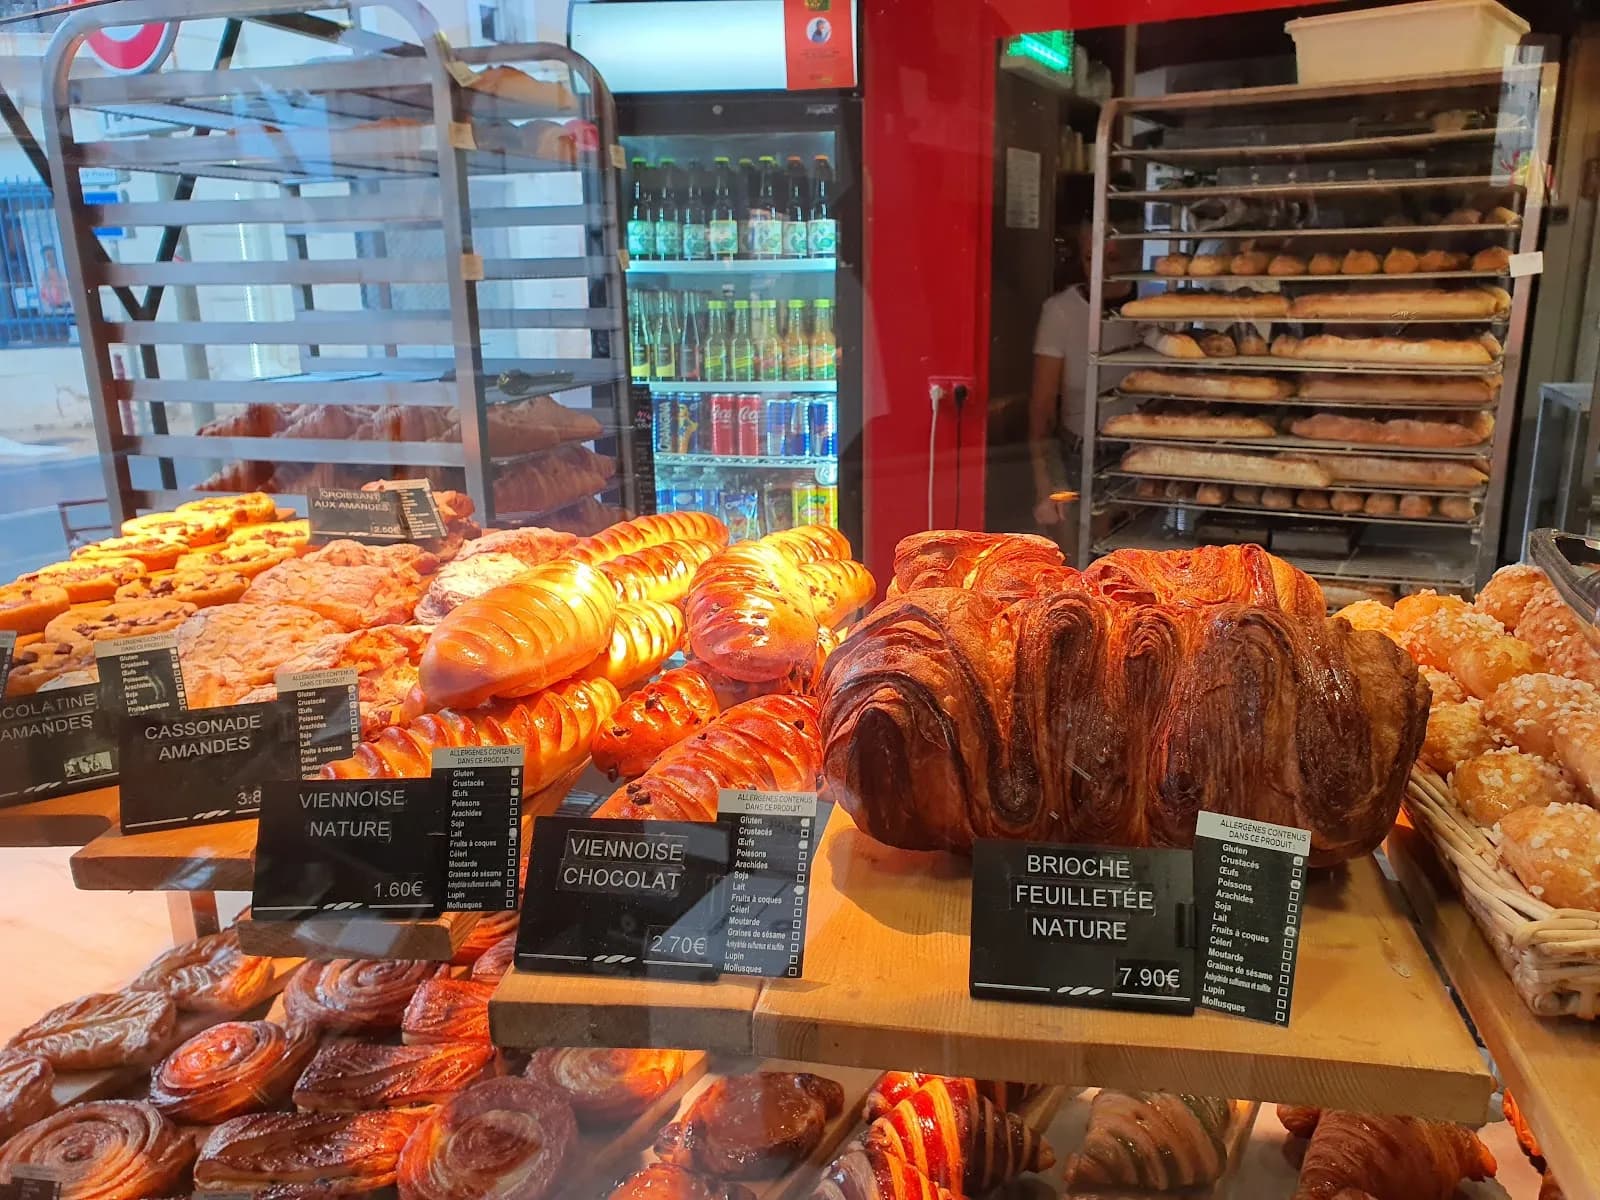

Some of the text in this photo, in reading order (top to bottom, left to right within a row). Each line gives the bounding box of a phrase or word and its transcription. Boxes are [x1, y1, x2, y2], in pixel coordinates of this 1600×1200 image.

[321, 491, 379, 500] CROISSANT
[314, 500, 389, 512] AUX AMANDES
[1, 714, 93, 741] AMANDES
[144, 714, 262, 740] CASSONADE
[158, 736, 251, 761] AMANDES
[299, 790, 405, 809] VIENNOISE
[452, 799, 480, 807] Poissons
[451, 809, 482, 817] Arachides
[451, 820, 465, 829] Soja
[740, 816, 763, 825] Gluten
[310, 821, 390, 837] NATURE
[739, 827, 773, 836] Crustacés
[1228, 831, 1249, 841] DANS
[1250, 834, 1261, 843] CE
[1261, 836, 1293, 849] PRODUIT
[1267, 828, 1307, 843] CONTENUS
[449, 840, 468, 848] Fruits
[737, 838, 755, 847] Œufs
[570, 838, 684, 862] VIENNOISE
[736, 848, 767, 858] Poissons
[1222, 843, 1248, 856] Gluten
[449, 860, 478, 868] Moutarde
[735, 859, 768, 869] Arachides
[1026, 854, 1131, 879] BRIOCHE
[1220, 854, 1260, 870] Crustacés
[734, 871, 749, 881] Soja
[1219, 866, 1240, 878] Œufs
[563, 867, 681, 891] CHOCOLAT
[1217, 877, 1253, 892] Poissons
[373, 881, 424, 898] 1.60€
[732, 882, 746, 891] Lait
[447, 891, 465, 900] Lupin
[731, 894, 751, 903] Fruits
[757, 896, 782, 905] coques
[1016, 883, 1155, 911] FEUILLETÉE
[1215, 889, 1254, 904] Arachides
[447, 902, 482, 910] Mollusques
[730, 904, 750, 914] Céleri
[1214, 900, 1232, 912] Soja
[728, 916, 760, 926] Moutarde
[1213, 912, 1228, 923] Lait
[727, 928, 786, 939] Graines de sésame
[1032, 917, 1128, 941] NATURE
[1211, 923, 1270, 944] Fruits à coques
[651, 935, 707, 956] 2.70€
[1209, 935, 1233, 948] Céleri
[725, 951, 745, 961] Lupin
[1208, 947, 1244, 962] Moutarde
[723, 963, 763, 974] Mollusques
[1206, 959, 1273, 981] Graines de sésame
[1119, 966, 1181, 989] 7.90€
[1203, 983, 1226, 996] Lupin
[1201, 995, 1246, 1013] Mollusques
